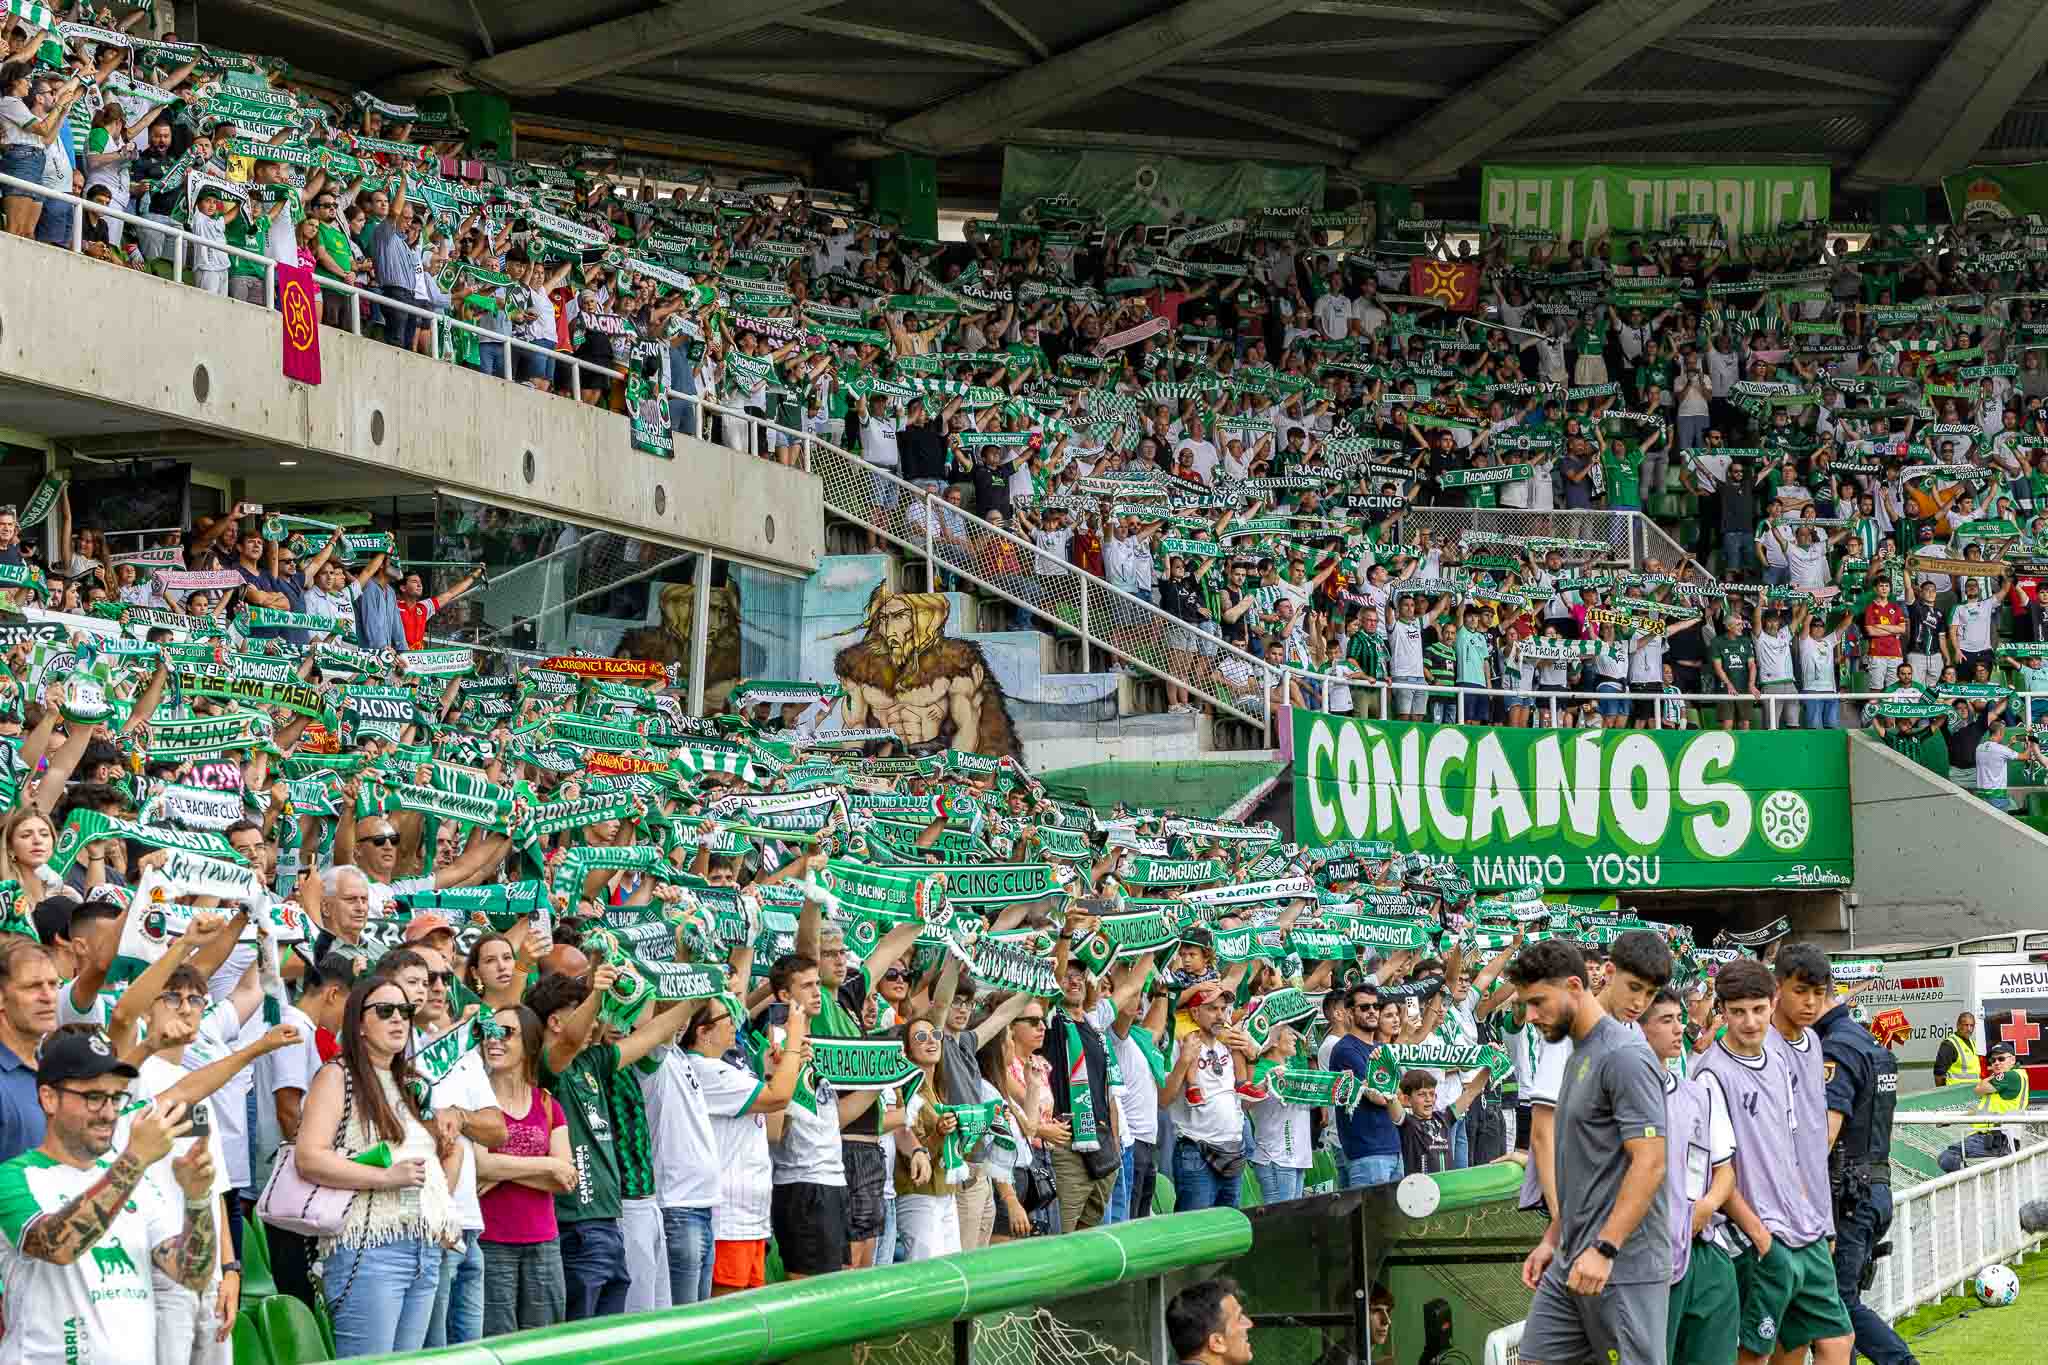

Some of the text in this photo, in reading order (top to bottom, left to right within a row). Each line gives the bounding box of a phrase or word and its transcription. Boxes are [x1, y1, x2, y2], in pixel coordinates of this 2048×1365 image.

[209, 98, 283, 121] Real Racing Club
[243, 120, 276, 137] RACING
[242, 144, 311, 164] SANTANDER
[1263, 206, 1311, 217] RACING
[963, 284, 1013, 301] RACING
[583, 313, 624, 335] RACING
[1296, 464, 1345, 481] RACING
[1463, 466, 1513, 484] RACINGUISTA
[1347, 495, 1403, 509] RACING
[139, 551, 176, 566] CLUB
[152, 610, 187, 629] RACING
[426, 651, 455, 665] RACING
[605, 659, 646, 676] RACING
[234, 654, 290, 683] RACINGUISTA
[479, 675, 506, 689] RACING
[1883, 704, 1901, 715] Real
[1901, 704, 1926, 718] Racing
[582, 726, 616, 745] RACING
[616, 732, 641, 747] CLUB
[957, 751, 998, 771] RACINGUIST
[185, 799, 218, 818] RACING
[530, 792, 628, 824] SANTANDE
[722, 798, 757, 817] REAL
[854, 795, 929, 809] RACING CLUB
[1149, 860, 1212, 881] RACINGUISTA
[1328, 860, 1359, 879] RACING
[1472, 856, 1565, 886] NANDO
[1585, 855, 1661, 885] YOSU
[504, 881, 538, 901] Club
[946, 869, 1047, 895] ACING CLUB
[1215, 880, 1311, 900] RACING CLUB
[857, 883, 887, 901] RACING
[1119, 919, 1149, 944] RACING
[1350, 919, 1414, 946] RACINGUISTA
[659, 971, 714, 997] NOS PERSIGUE
[1876, 993, 1898, 1002] VITAL
[1901, 991, 1944, 1001] AVANZADO
[1930, 1023, 1954, 1040] Roja
[814, 1048, 837, 1077] EAL
[837, 1050, 876, 1077] RACING
[1391, 1043, 1481, 1065] RACINGUISTA
[575, 1144, 588, 1205] CANTABRIA
